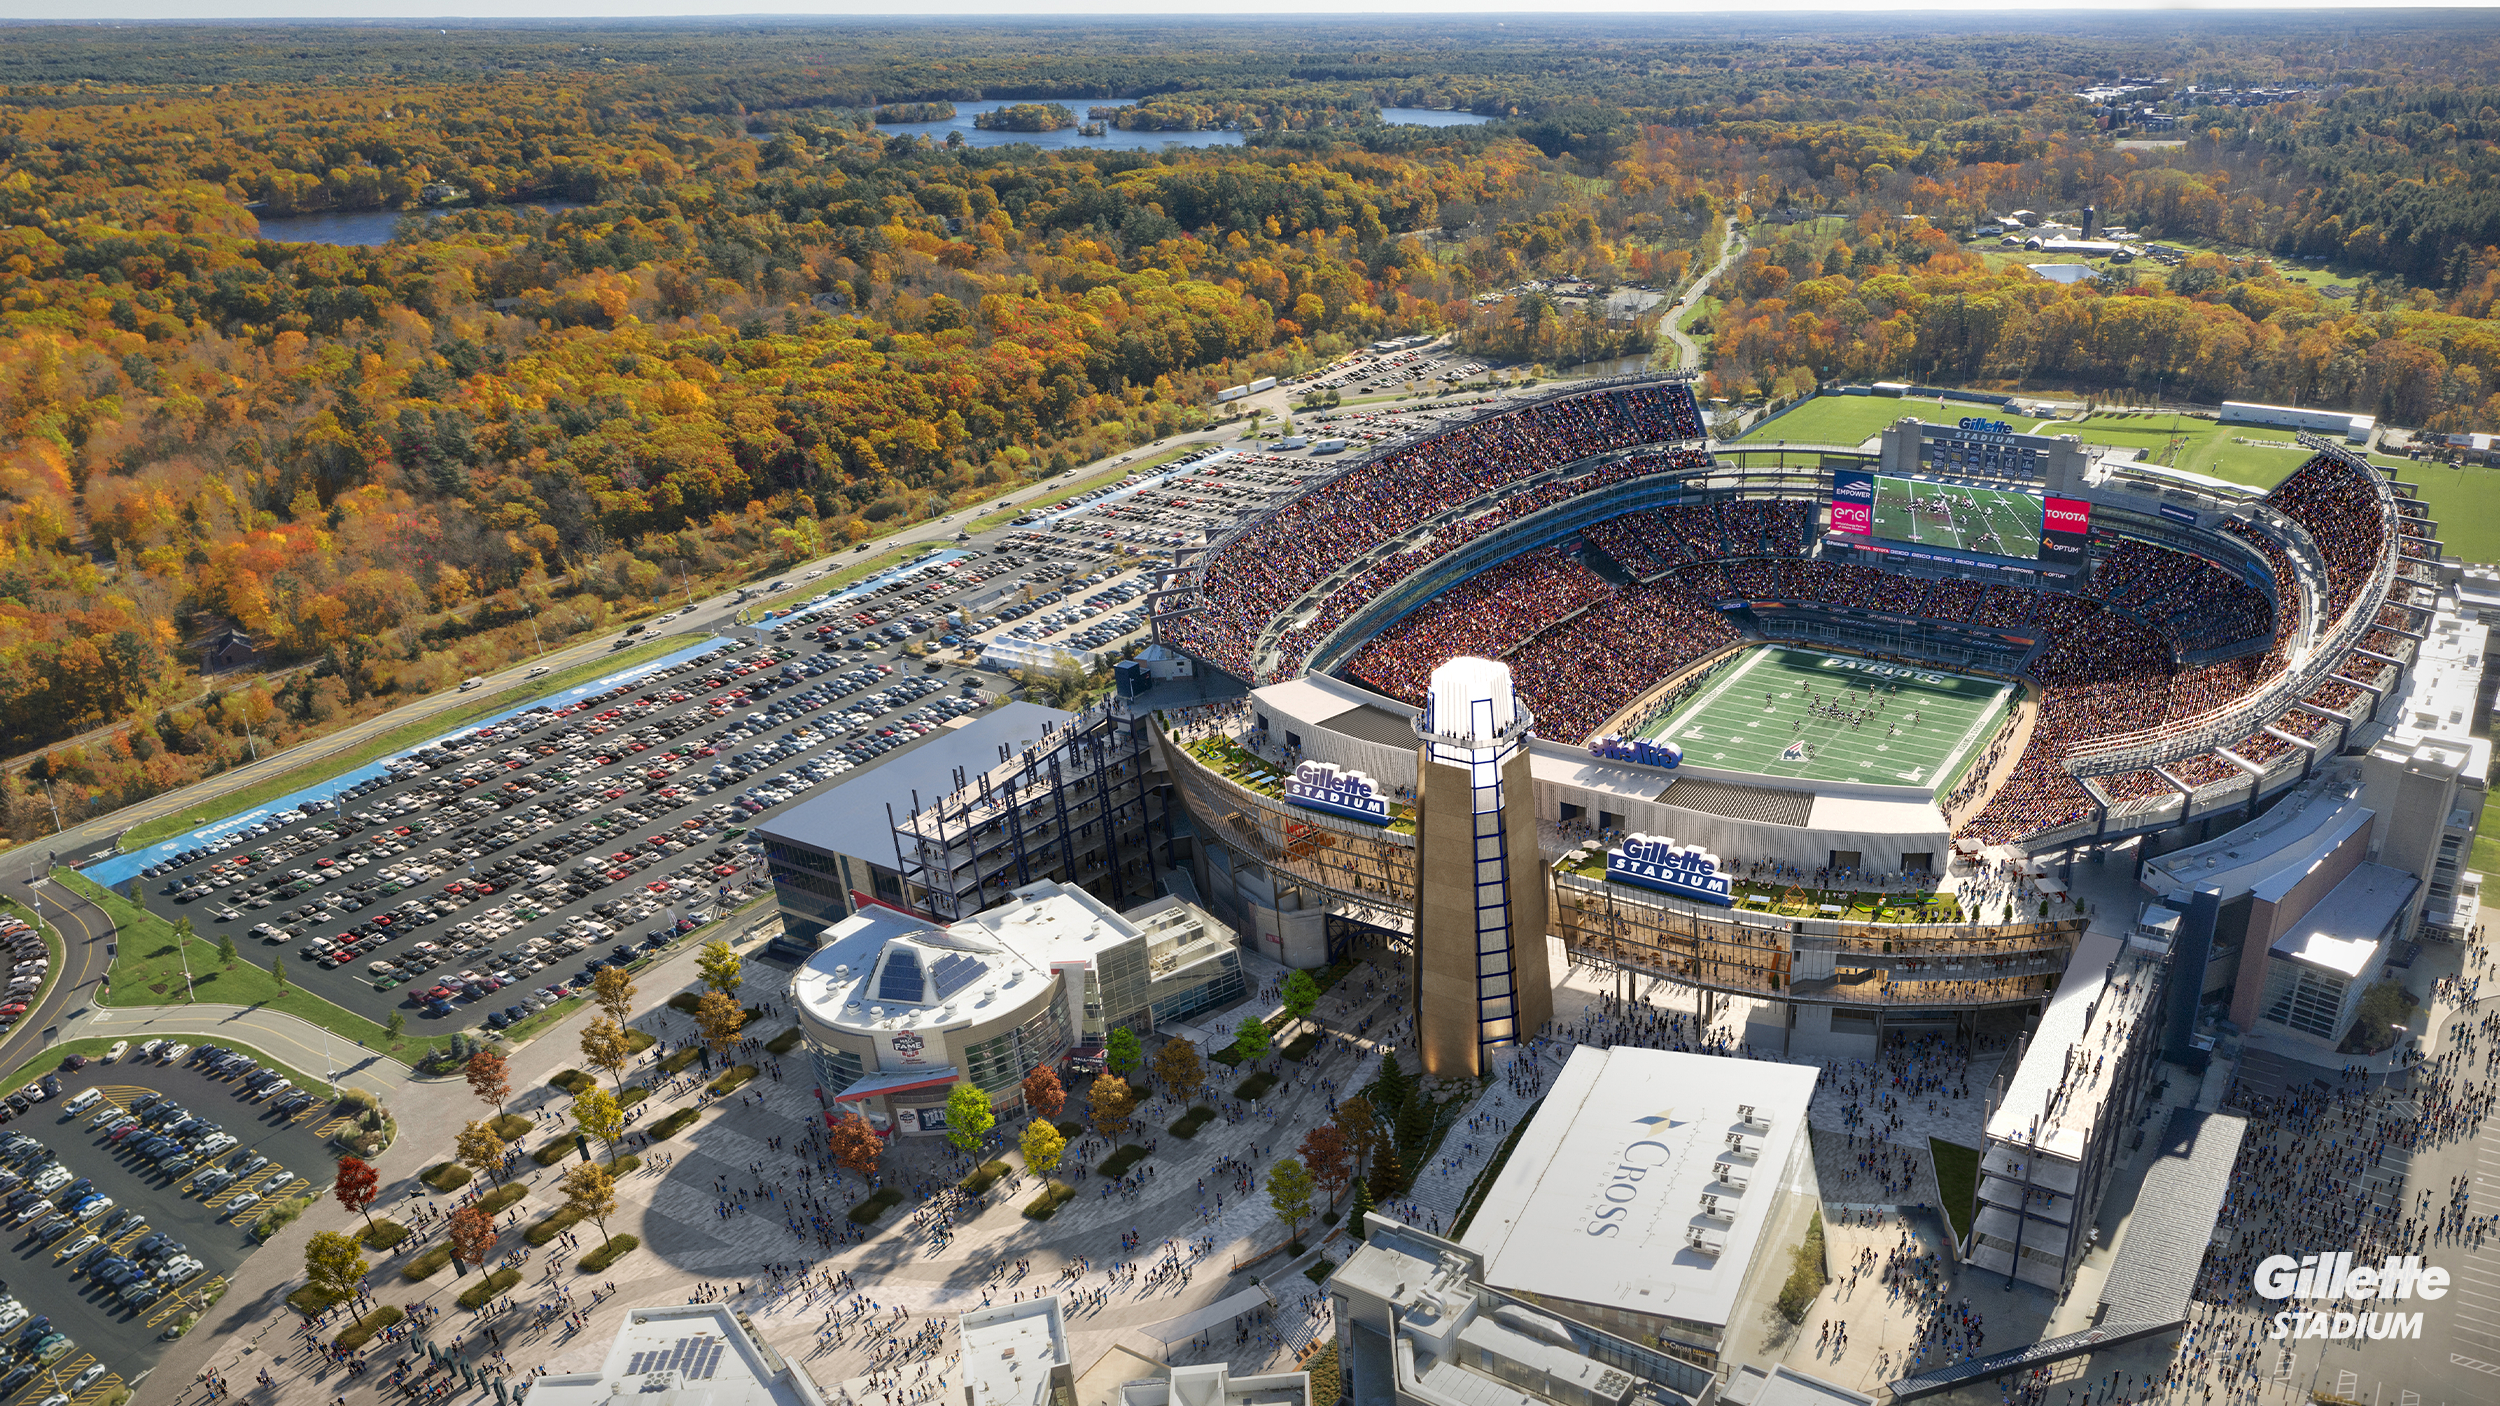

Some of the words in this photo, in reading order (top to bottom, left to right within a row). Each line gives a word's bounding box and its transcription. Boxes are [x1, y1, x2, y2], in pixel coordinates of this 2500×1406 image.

[1958, 417, 2013, 434] Gillette
[1955, 431, 2015, 445] STADIUM
[1836, 488, 1871, 498] EMPOWER
[1834, 507, 1869, 522] enel
[2046, 509, 2086, 522] TOYOTA
[2053, 544, 2079, 553] OPTUM
[1840, 618, 1876, 628] OPTUM
[1973, 640, 2012, 650] OPTUM
[1822, 658, 1944, 684] PATRIOTS
[1296, 763, 1373, 798] Gillette
[1292, 784, 1380, 812] STADIUM
[193, 809, 268, 839] Putnam
[1622, 836, 1716, 876] Gillette
[1615, 858, 1723, 892] STADIUM
[894, 1042, 922, 1050] FAME
[1573, 1142, 1626, 1234] INSURANCE
[1586, 1140, 1670, 1239] CROSS
[1983, 1356, 2014, 1371] BANK
[2033, 1340, 2080, 1357] AMERICA
